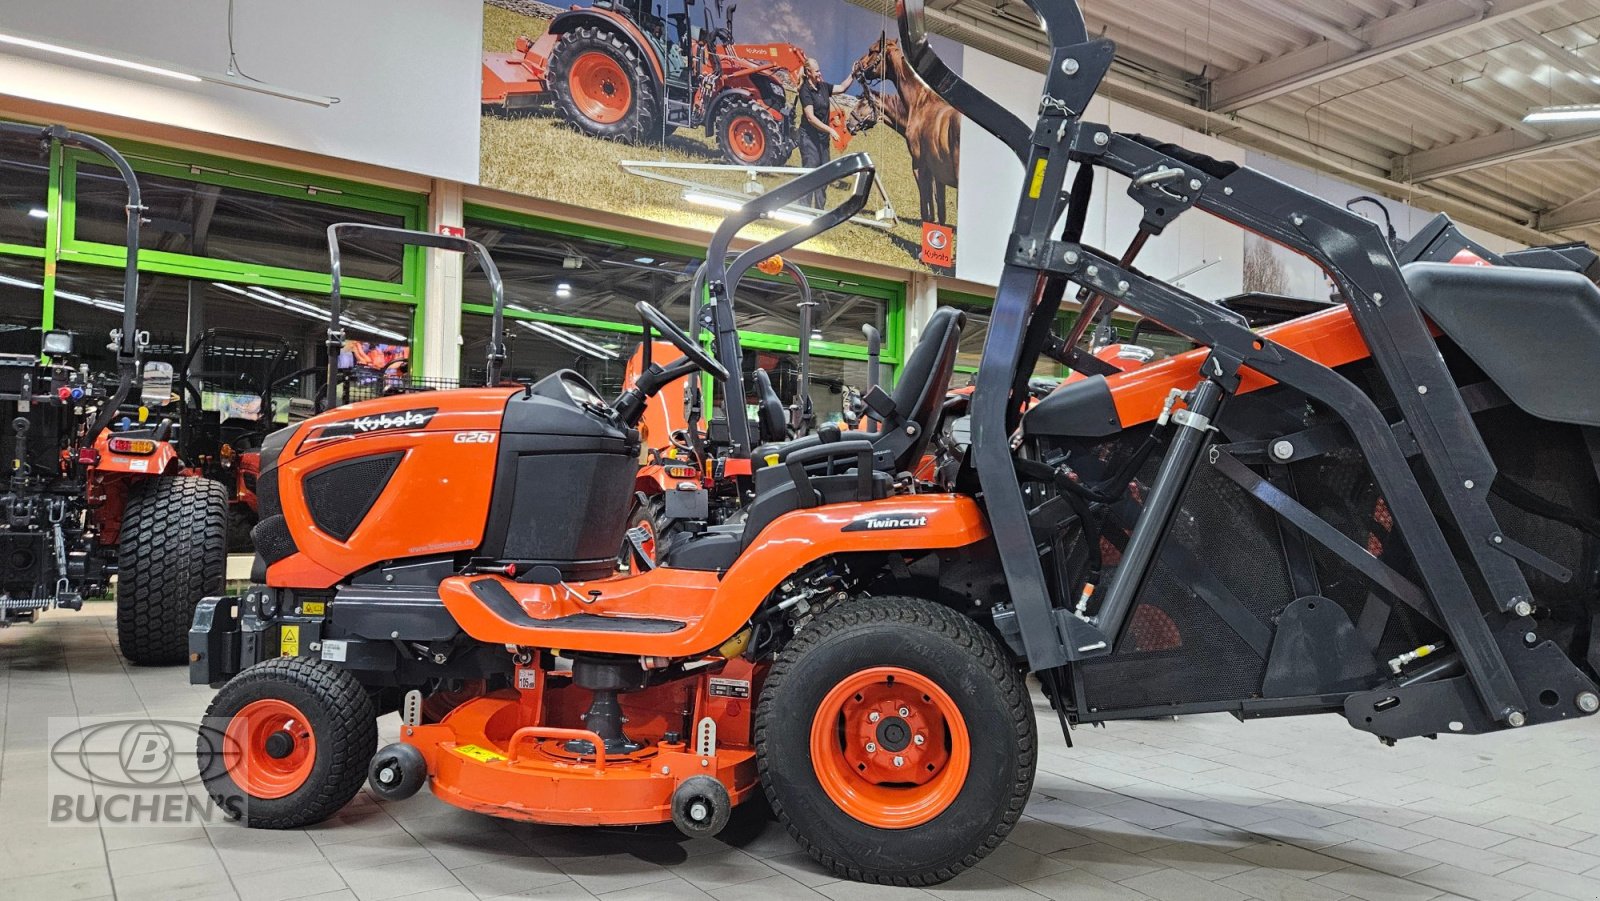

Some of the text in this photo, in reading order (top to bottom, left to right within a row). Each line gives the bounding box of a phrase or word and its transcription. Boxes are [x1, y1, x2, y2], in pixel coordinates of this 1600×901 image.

[925, 249, 949, 262] Kubota
[353, 410, 425, 432] Kubota
[453, 432, 496, 444] G261
